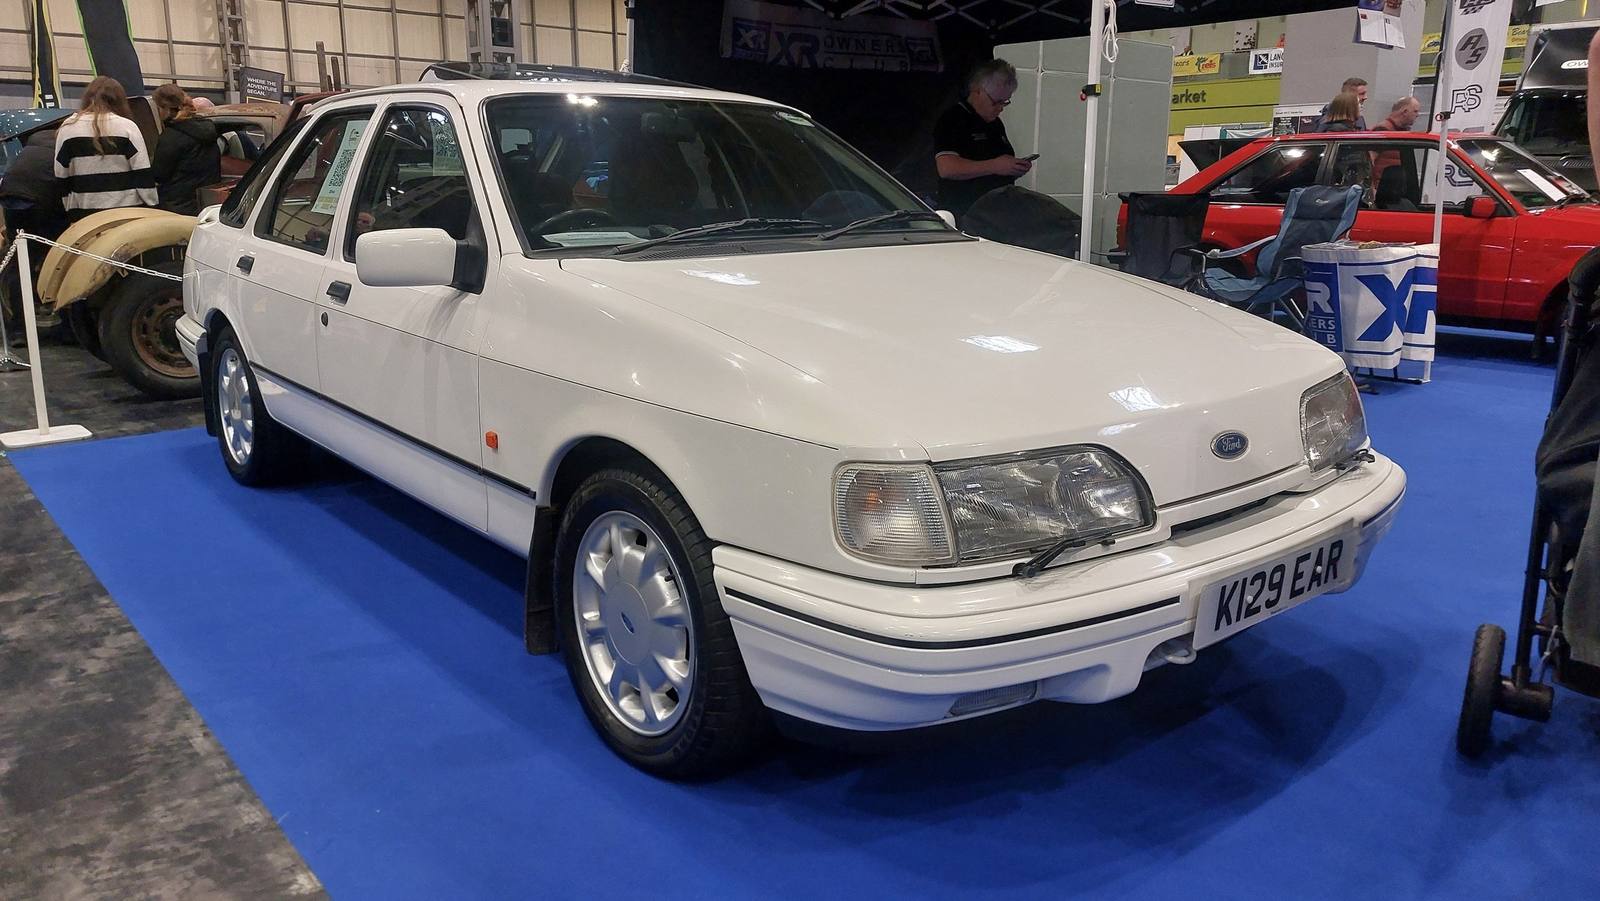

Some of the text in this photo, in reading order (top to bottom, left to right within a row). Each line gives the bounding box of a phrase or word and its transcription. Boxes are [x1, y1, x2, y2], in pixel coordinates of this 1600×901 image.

[1221, 436, 1242, 452] Ford
[1214, 540, 1344, 632] K129 EAR
